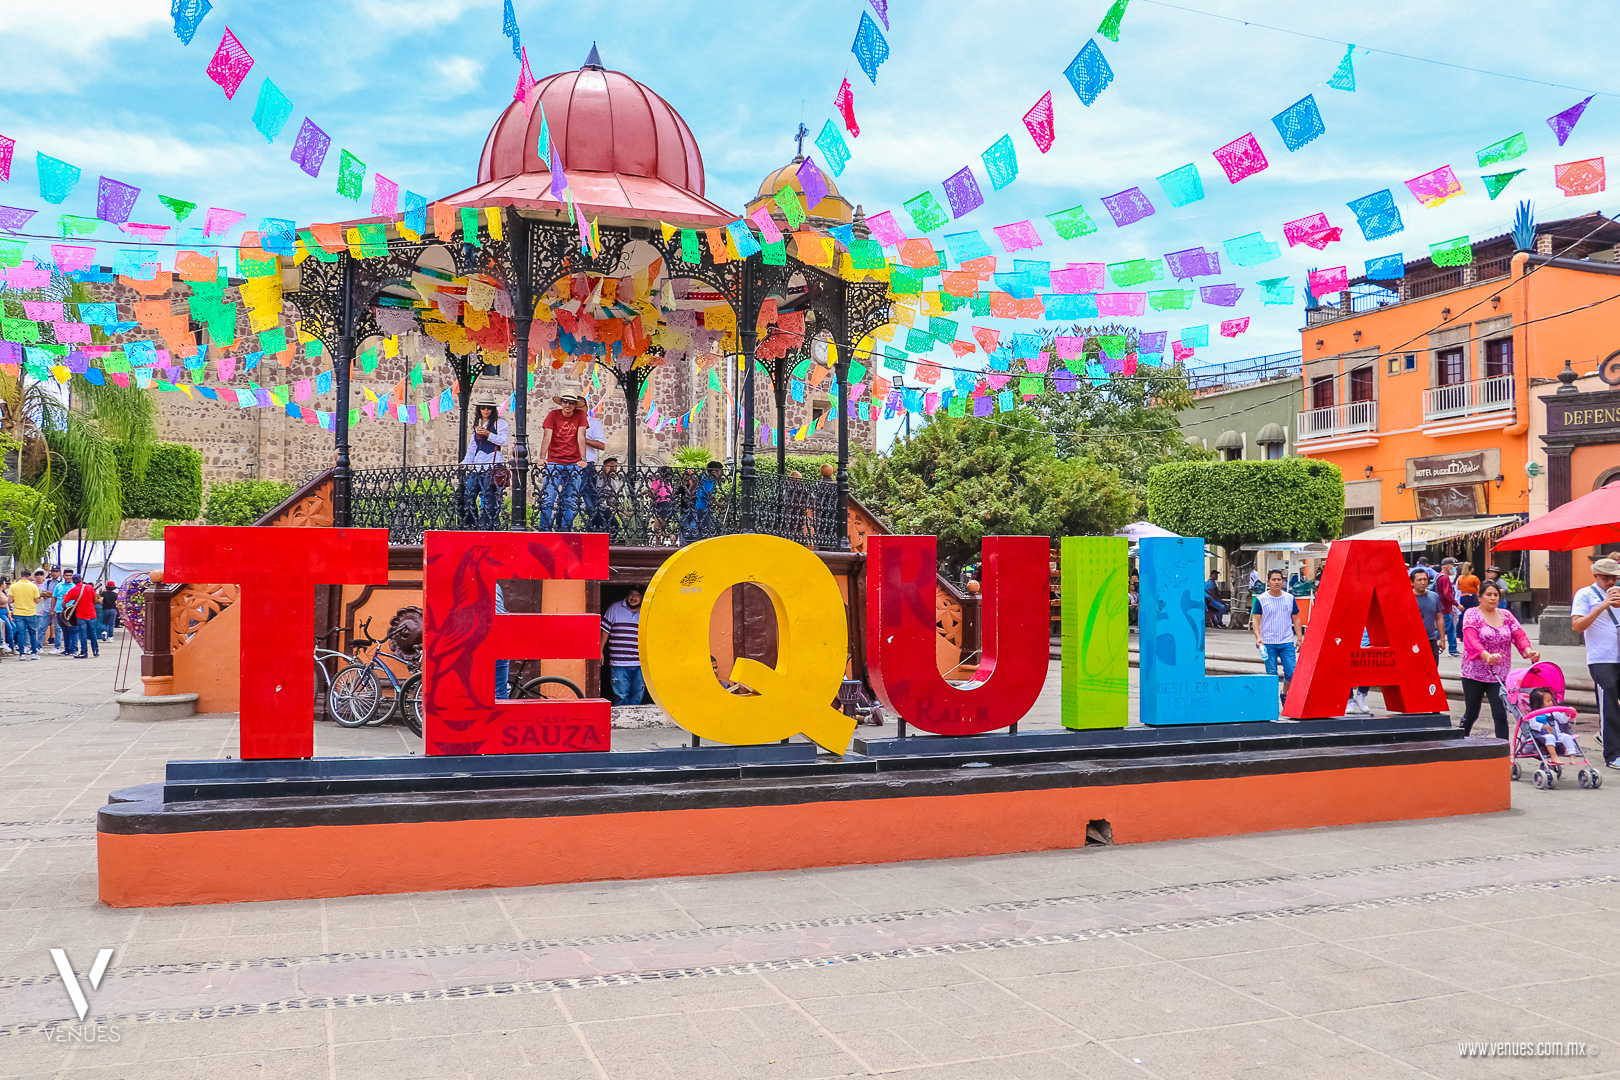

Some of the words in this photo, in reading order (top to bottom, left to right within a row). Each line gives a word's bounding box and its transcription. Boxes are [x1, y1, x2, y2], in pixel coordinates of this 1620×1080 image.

[1416, 468, 1432, 477] HOTEL
[164, 526, 1450, 760] TEQUILA
[1350, 651, 1396, 668] MATICES
[535, 716, 568, 724] CASA
[501, 725, 602, 750] SAUZA
